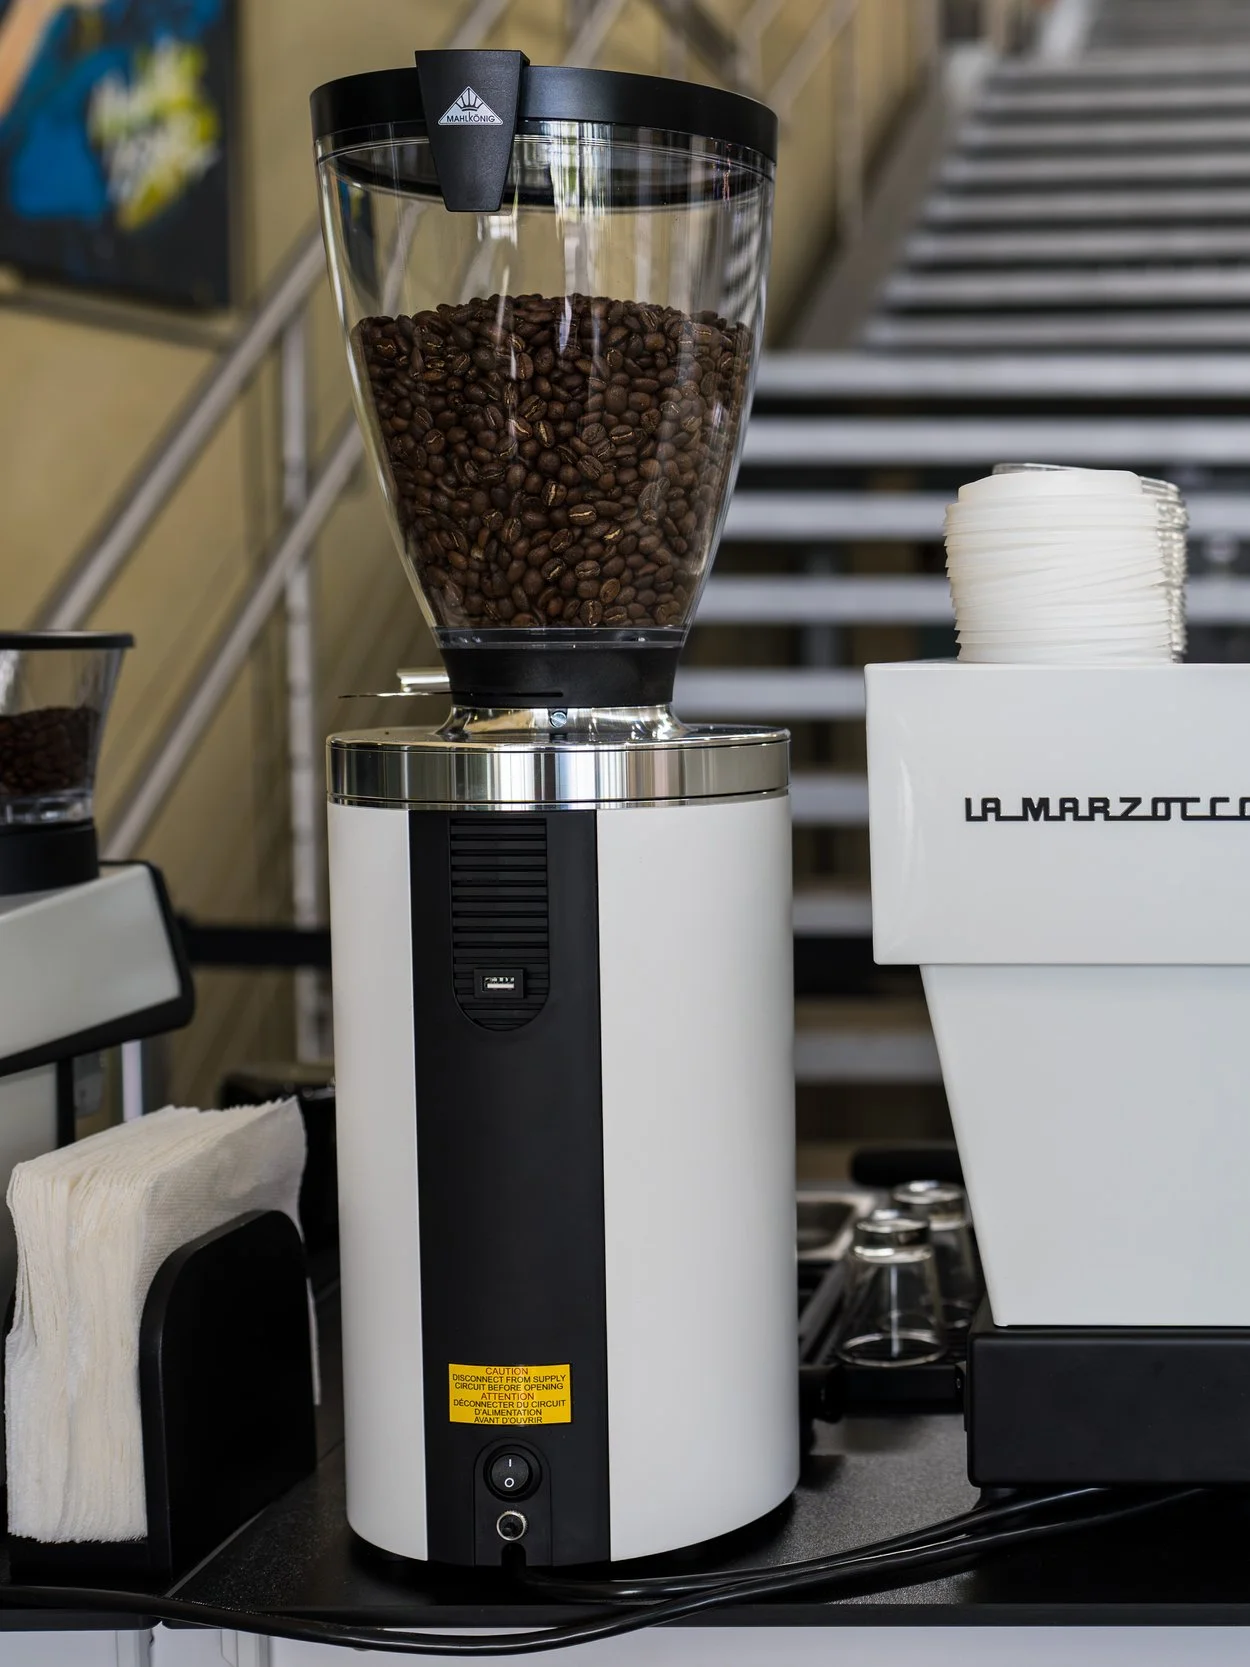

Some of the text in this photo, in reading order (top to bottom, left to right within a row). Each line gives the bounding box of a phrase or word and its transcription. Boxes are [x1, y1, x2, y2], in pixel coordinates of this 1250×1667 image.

[964, 797, 1000, 821] LA
[486, 1367, 528, 1375] CAUTION
[452, 1374, 503, 1383] DISCONNECT
[455, 1383, 485, 1391] CIRCUIT
[524, 1383, 563, 1391] OPENING
[481, 1392, 534, 1400] ATTENTION
[453, 1399, 514, 1408] DÉCONNECTER
[474, 1408, 542, 1416] D'ALIMENTATION
